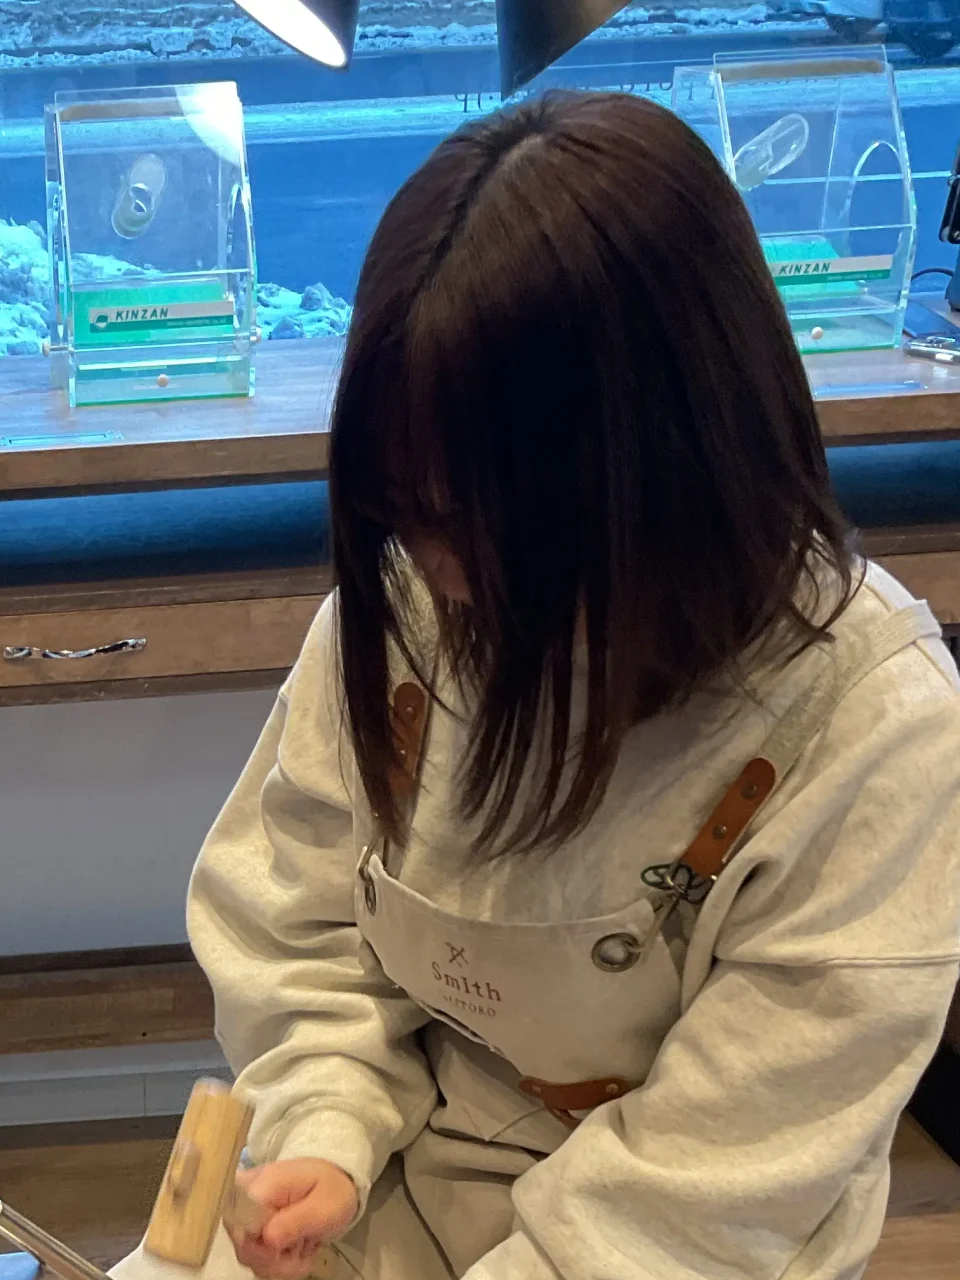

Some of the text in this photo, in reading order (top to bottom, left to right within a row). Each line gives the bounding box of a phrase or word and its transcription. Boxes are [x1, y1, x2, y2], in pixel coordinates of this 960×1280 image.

[779, 262, 831, 275] KINZAN
[115, 307, 169, 321] KINZAN
[431, 961, 502, 1002] Smith
